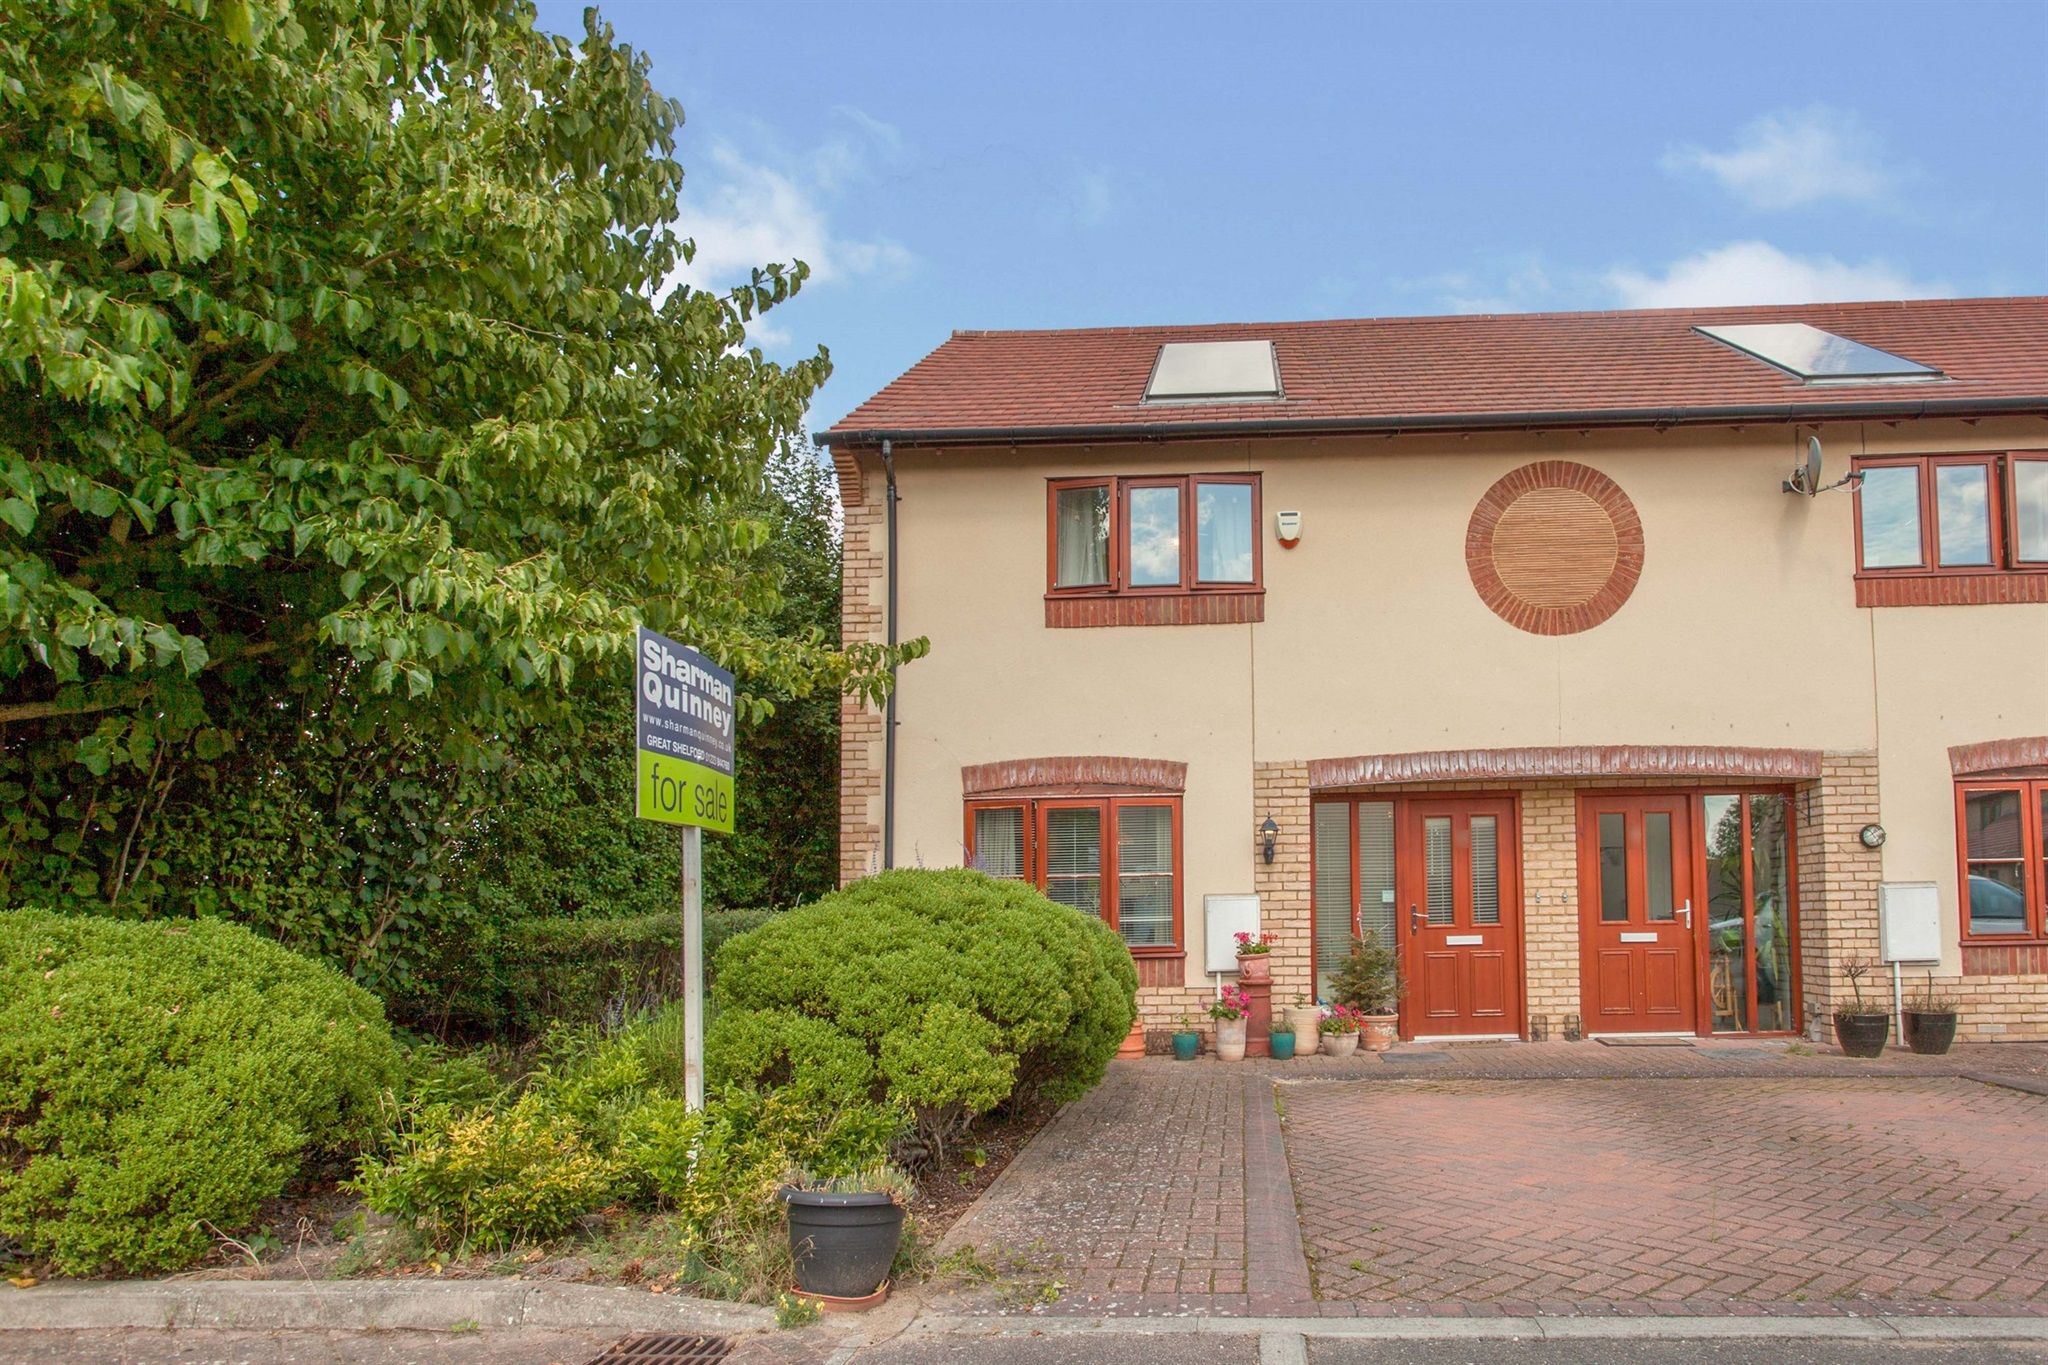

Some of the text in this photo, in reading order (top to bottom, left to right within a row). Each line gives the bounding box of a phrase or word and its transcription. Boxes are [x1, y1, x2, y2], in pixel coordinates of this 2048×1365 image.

[642, 671, 732, 737] Quinney
[643, 639, 732, 707] Sharman
[646, 734, 705, 761] GREAT SHELFORD
[651, 762, 727, 823] for sale
